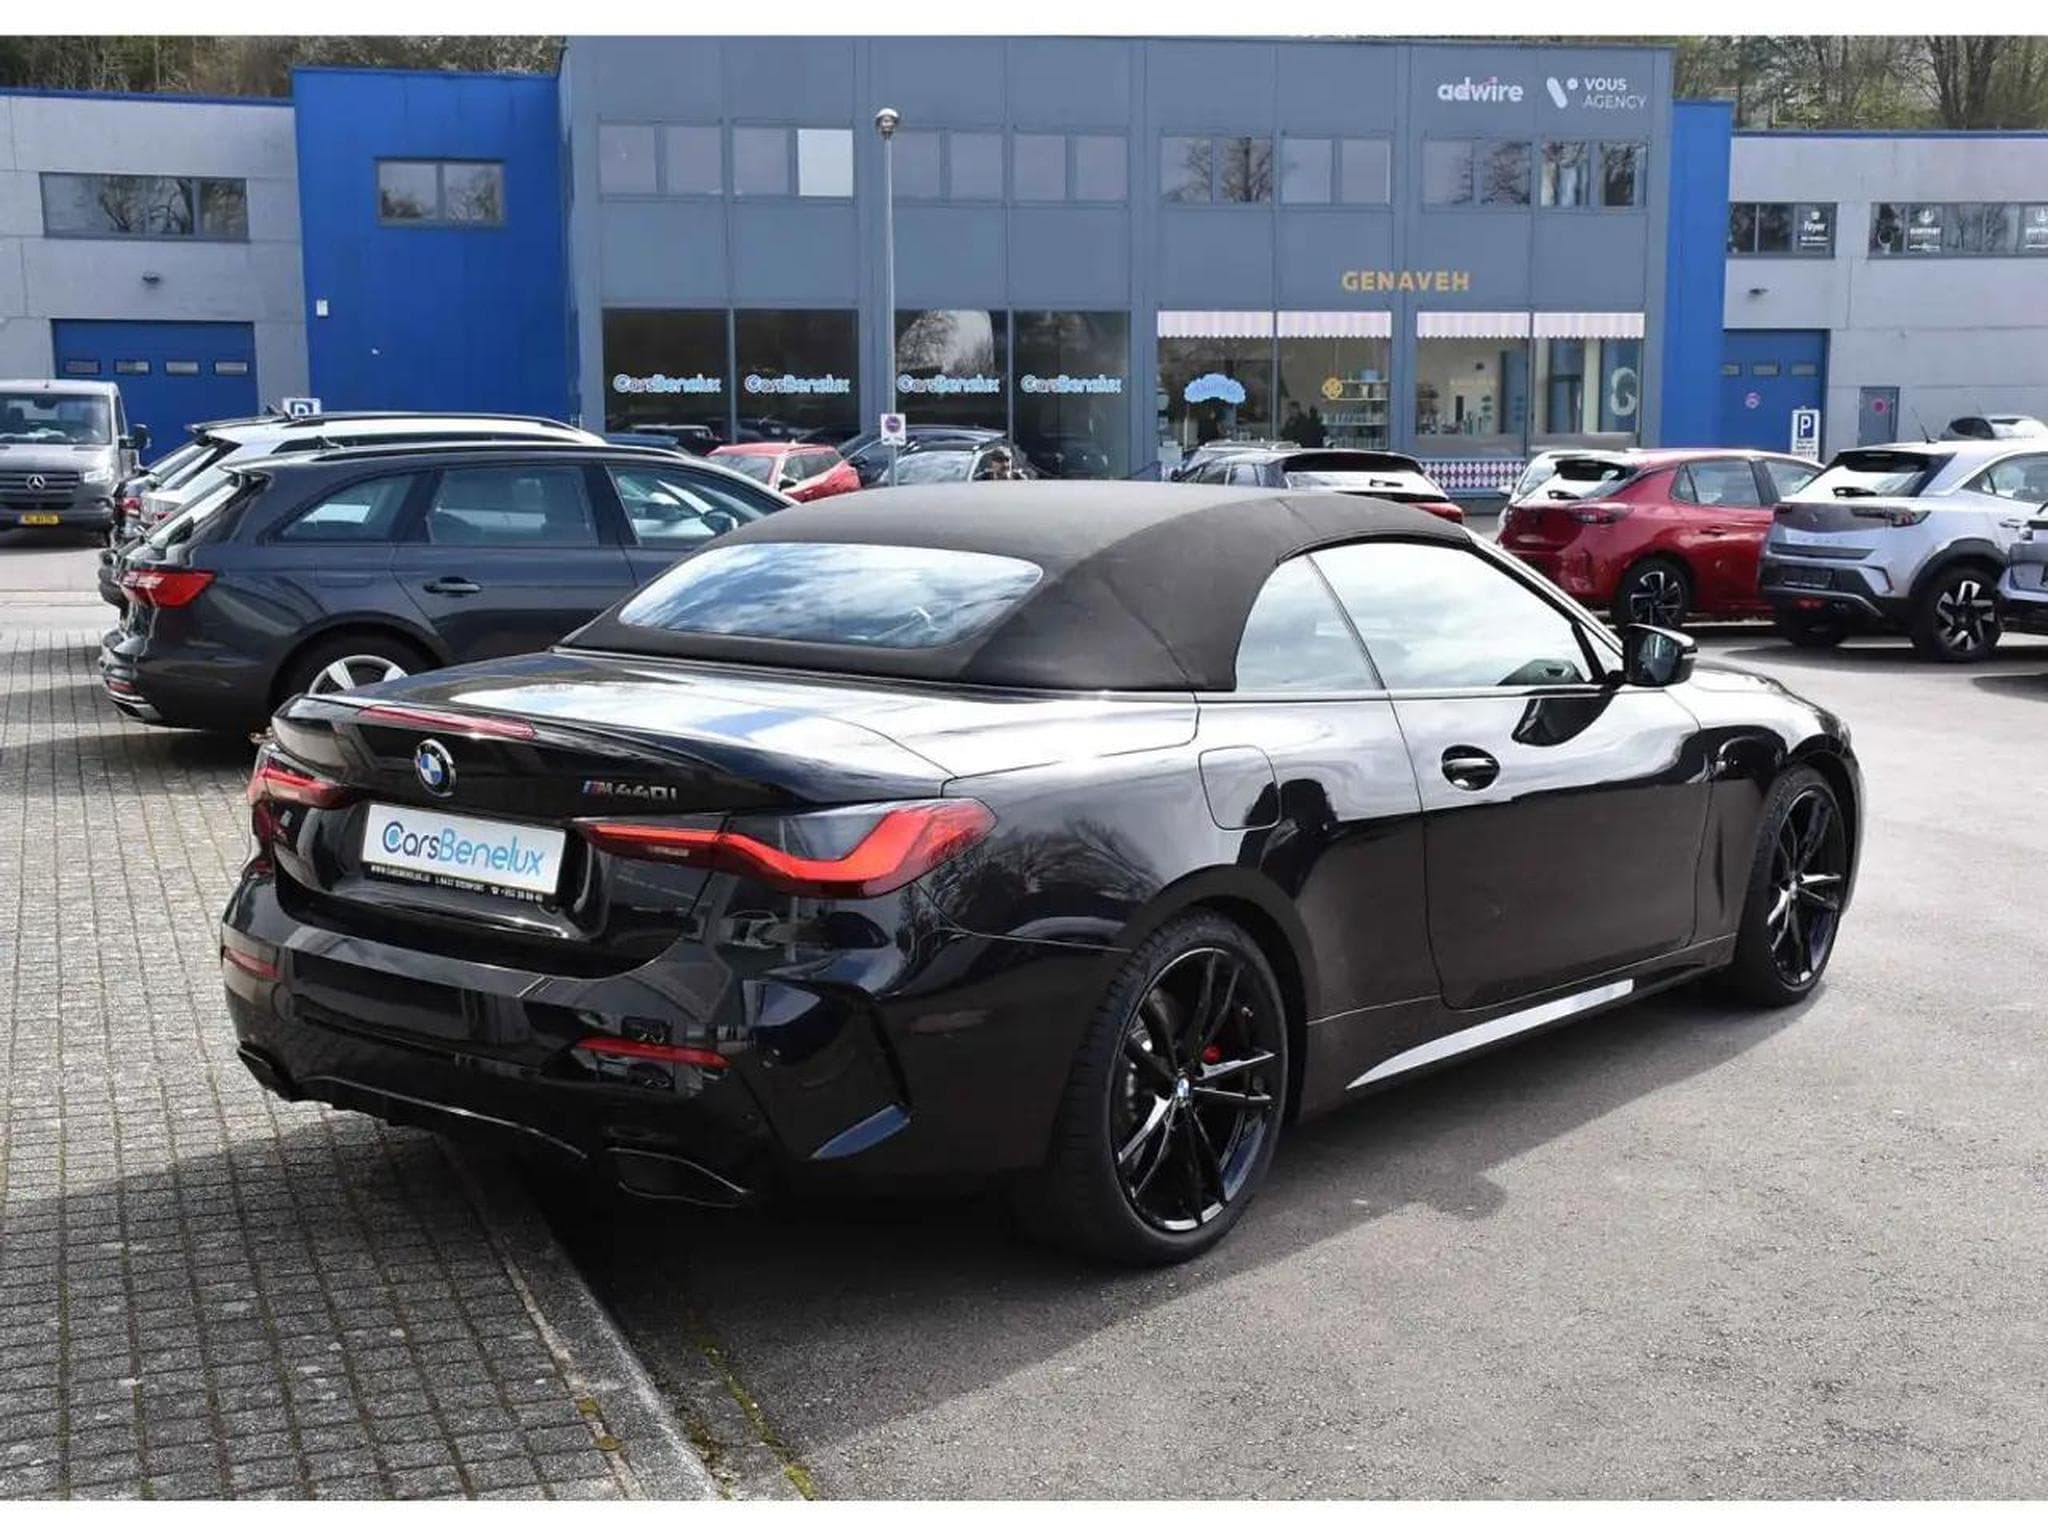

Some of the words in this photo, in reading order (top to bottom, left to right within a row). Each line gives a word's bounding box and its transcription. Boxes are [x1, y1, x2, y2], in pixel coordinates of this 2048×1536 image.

[1437, 76, 1524, 103] adwire
[1584, 77, 1627, 91] VOUS
[1583, 94, 1647, 109] AGENCY
[1341, 270, 1471, 292] GENAVEH
[613, 373, 722, 393] CarsBenelux
[744, 373, 850, 393] CarsBenelux
[897, 373, 1000, 393] CarsBenelux
[1020, 373, 1122, 393] CarsBenelux
[1611, 366, 1637, 416] G
[1800, 415, 1812, 437] P
[382, 821, 544, 877] CarsBenelux
